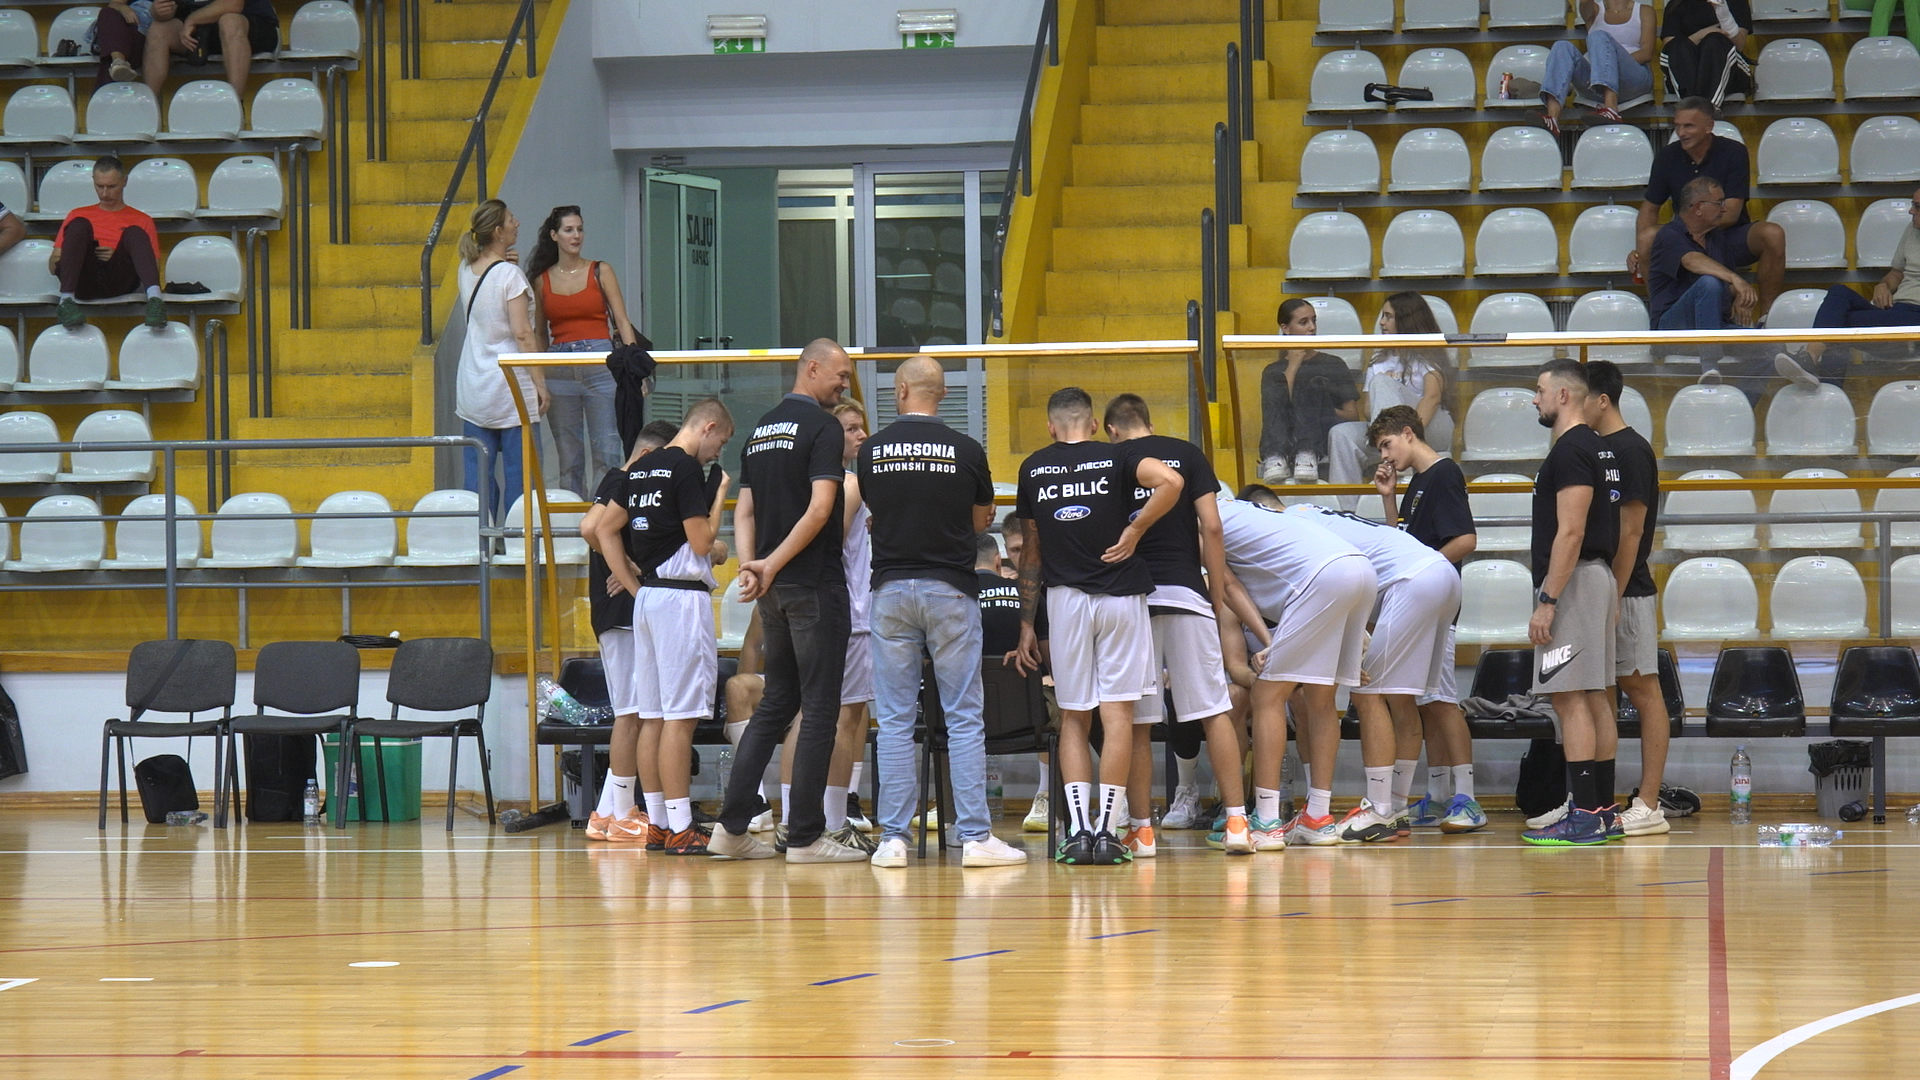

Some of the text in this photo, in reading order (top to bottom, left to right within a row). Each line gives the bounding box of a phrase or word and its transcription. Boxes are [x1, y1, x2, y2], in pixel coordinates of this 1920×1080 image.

[753, 422, 799, 439] MARSONIA
[883, 443, 956, 459] MARSONIA
[872, 462, 956, 474] SLAVONSKI BROD
[1030, 466, 1068, 478] OMODA
[1038, 477, 1109, 503] AC BILIĆ
[995, 600, 1020, 609] BROD
[1541, 644, 1572, 671] NIKE
